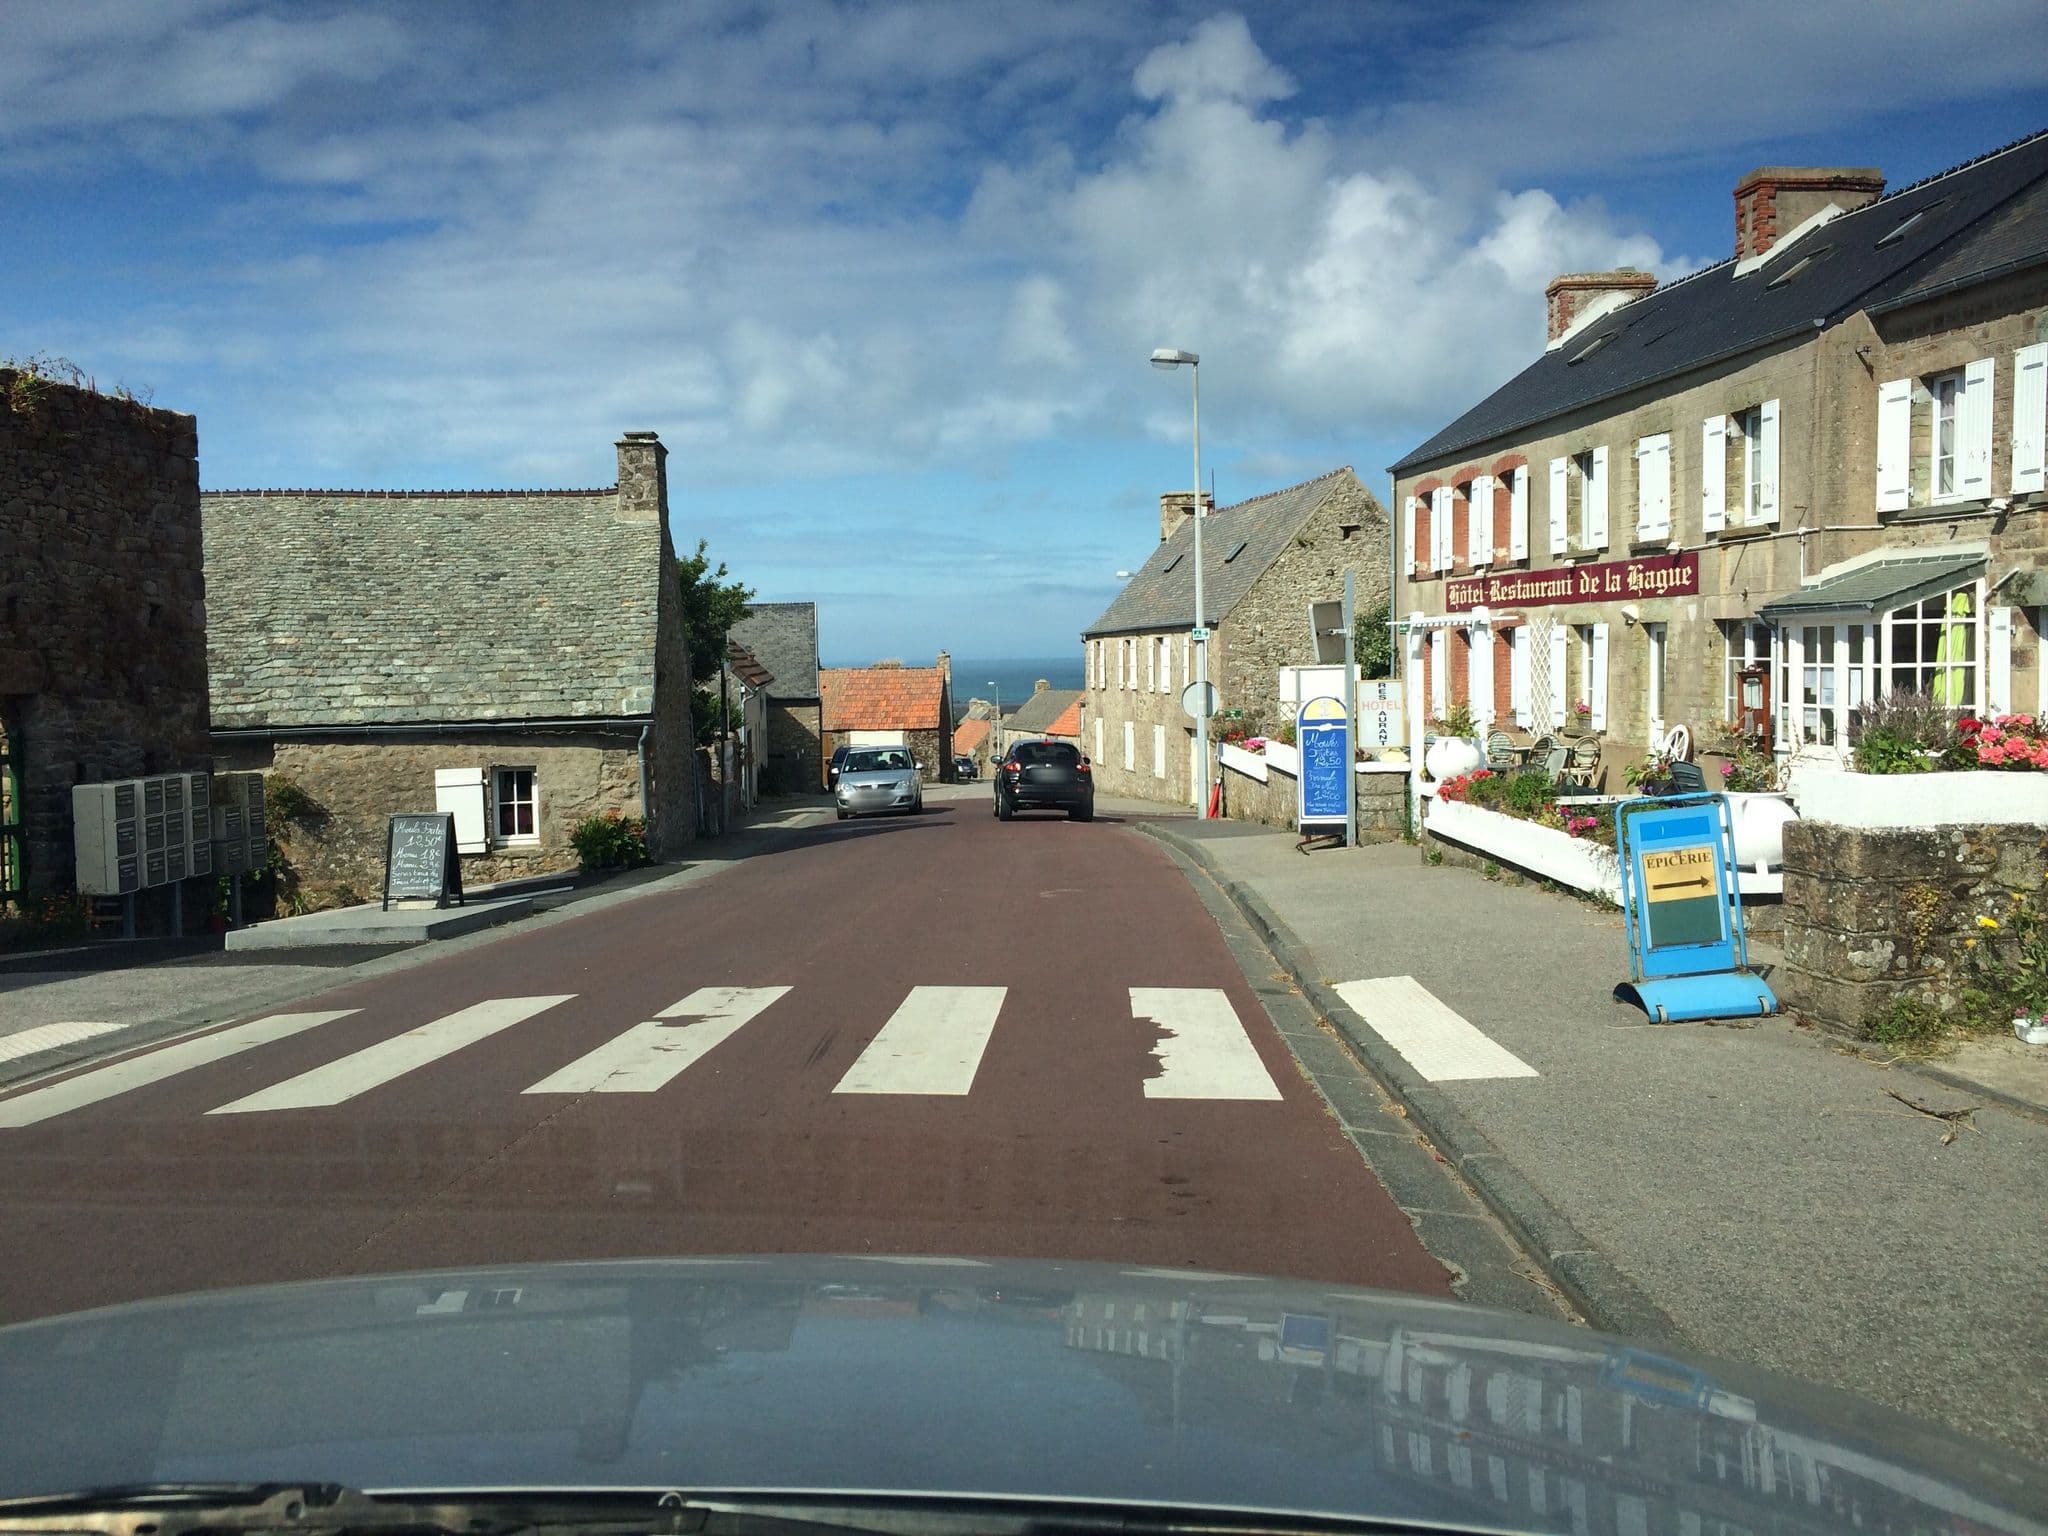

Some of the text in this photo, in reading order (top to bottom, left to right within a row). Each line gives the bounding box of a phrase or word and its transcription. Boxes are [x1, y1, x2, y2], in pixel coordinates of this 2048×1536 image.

[1579, 570, 1600, 595] de
[1604, 567, 1621, 593] la
[1627, 563, 1693, 597] Hague
[1361, 700, 1401, 711] HOTEL
